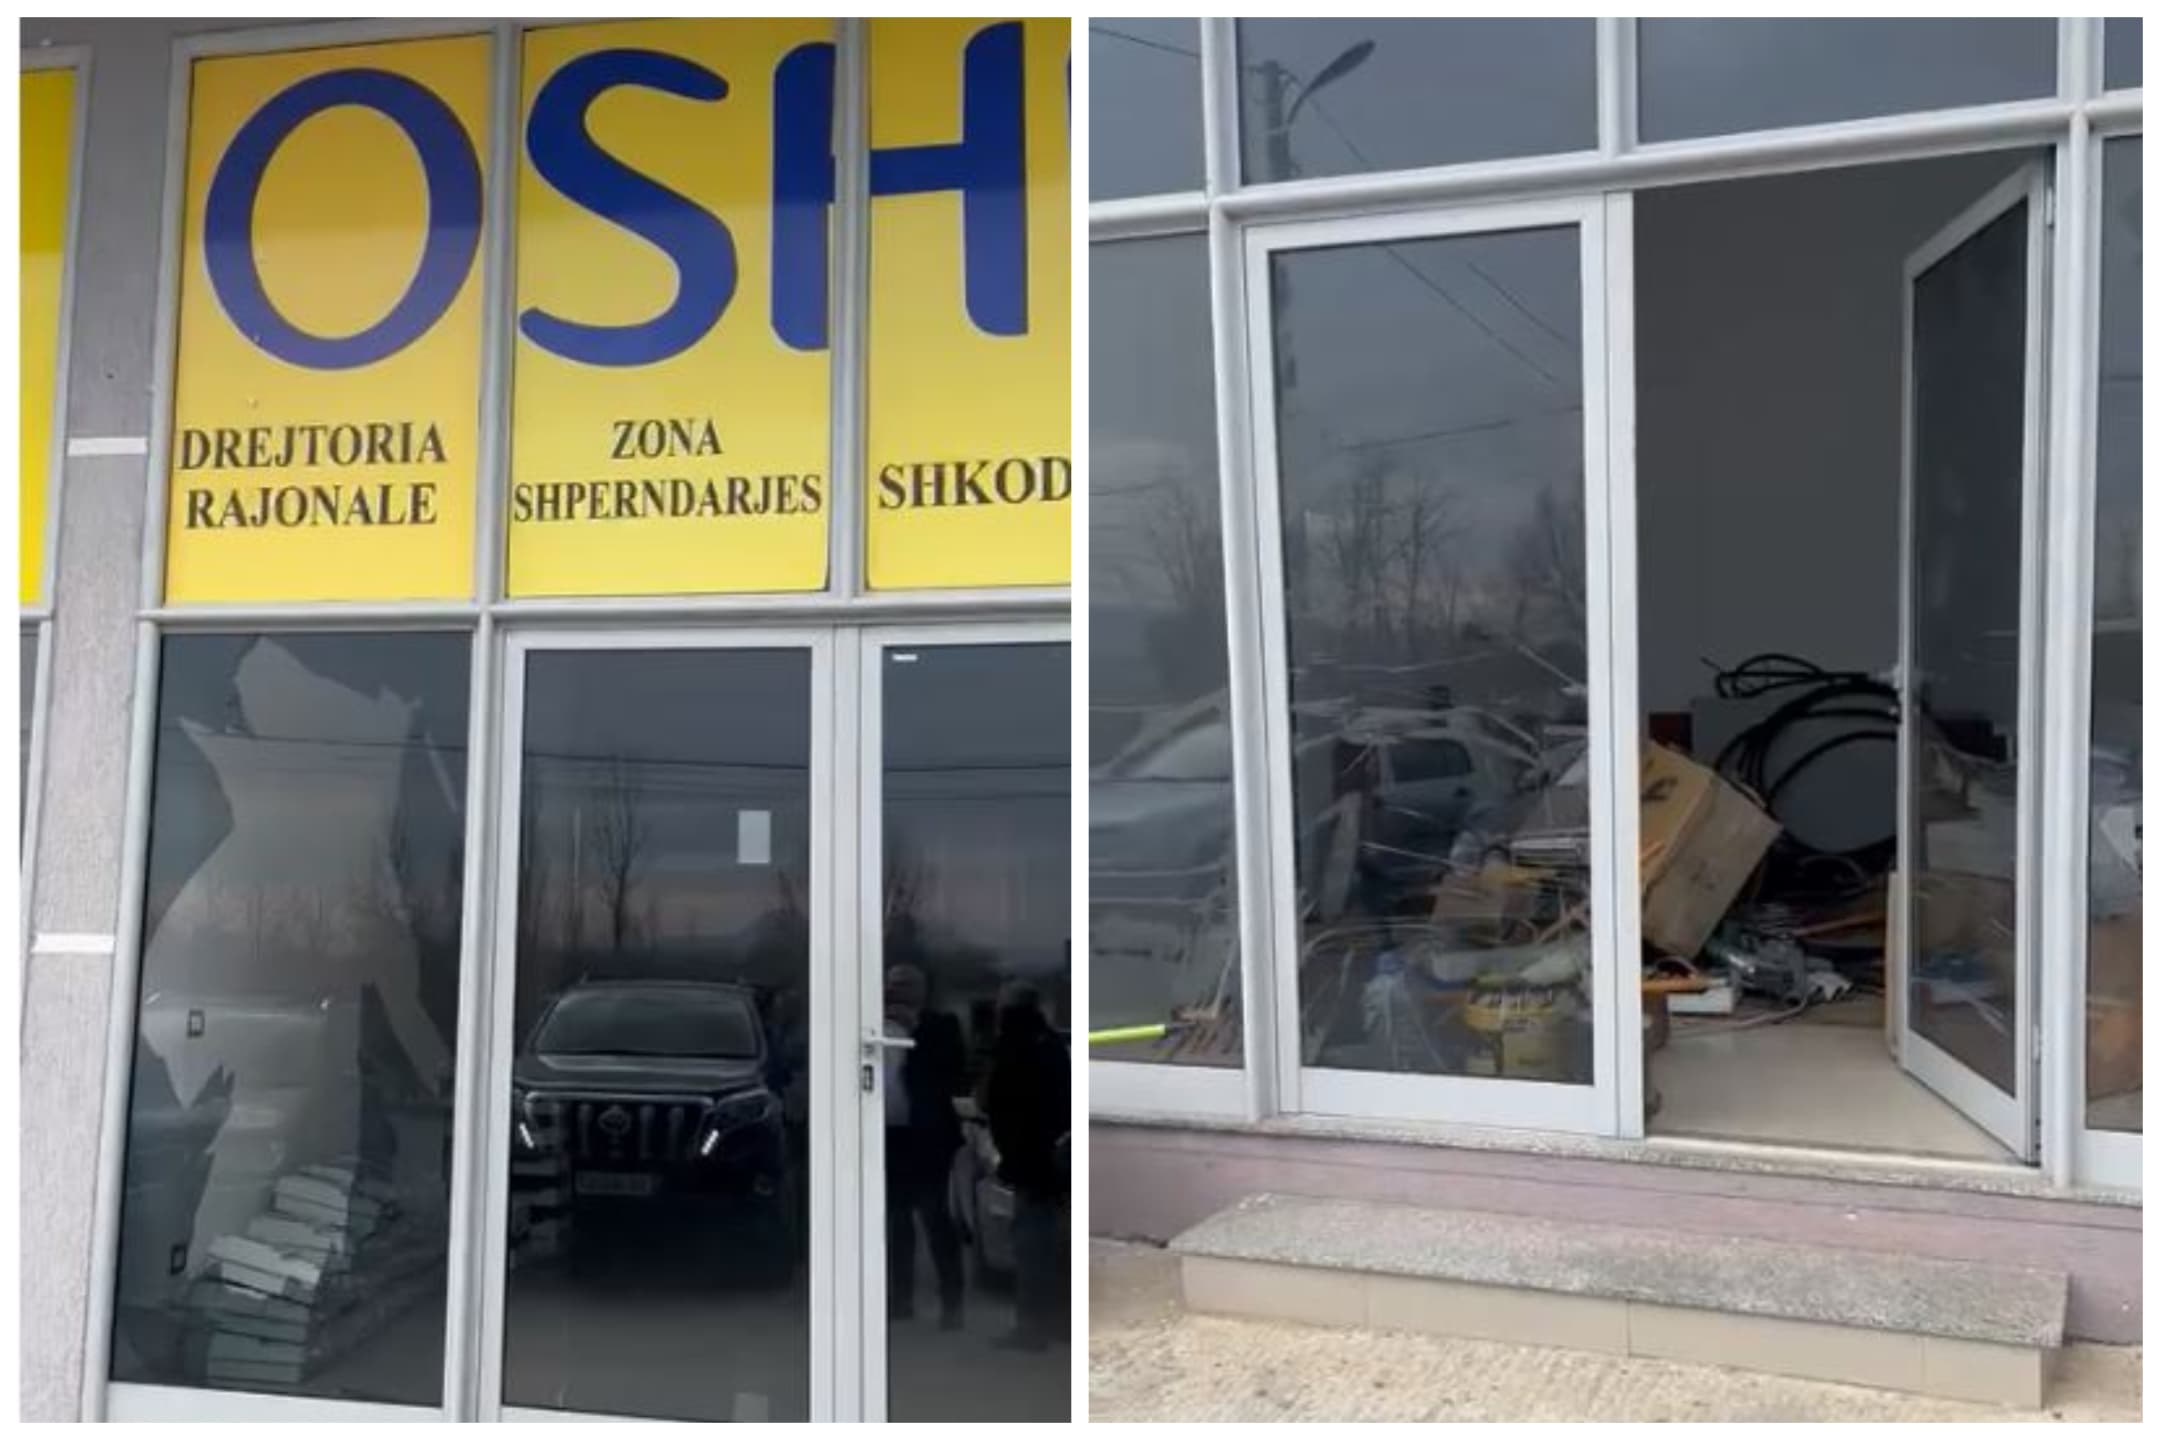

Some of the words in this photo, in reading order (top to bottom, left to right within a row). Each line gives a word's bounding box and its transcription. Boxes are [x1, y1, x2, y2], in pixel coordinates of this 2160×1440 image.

[204, 21, 1071, 370] OSH
[180, 421, 447, 470] DREJTORIA
[611, 418, 722, 460] ZONA
[185, 482, 438, 529] RAJONALE
[513, 475, 823, 522] SHPERNDARJES
[878, 456, 1071, 510] SHKOD
